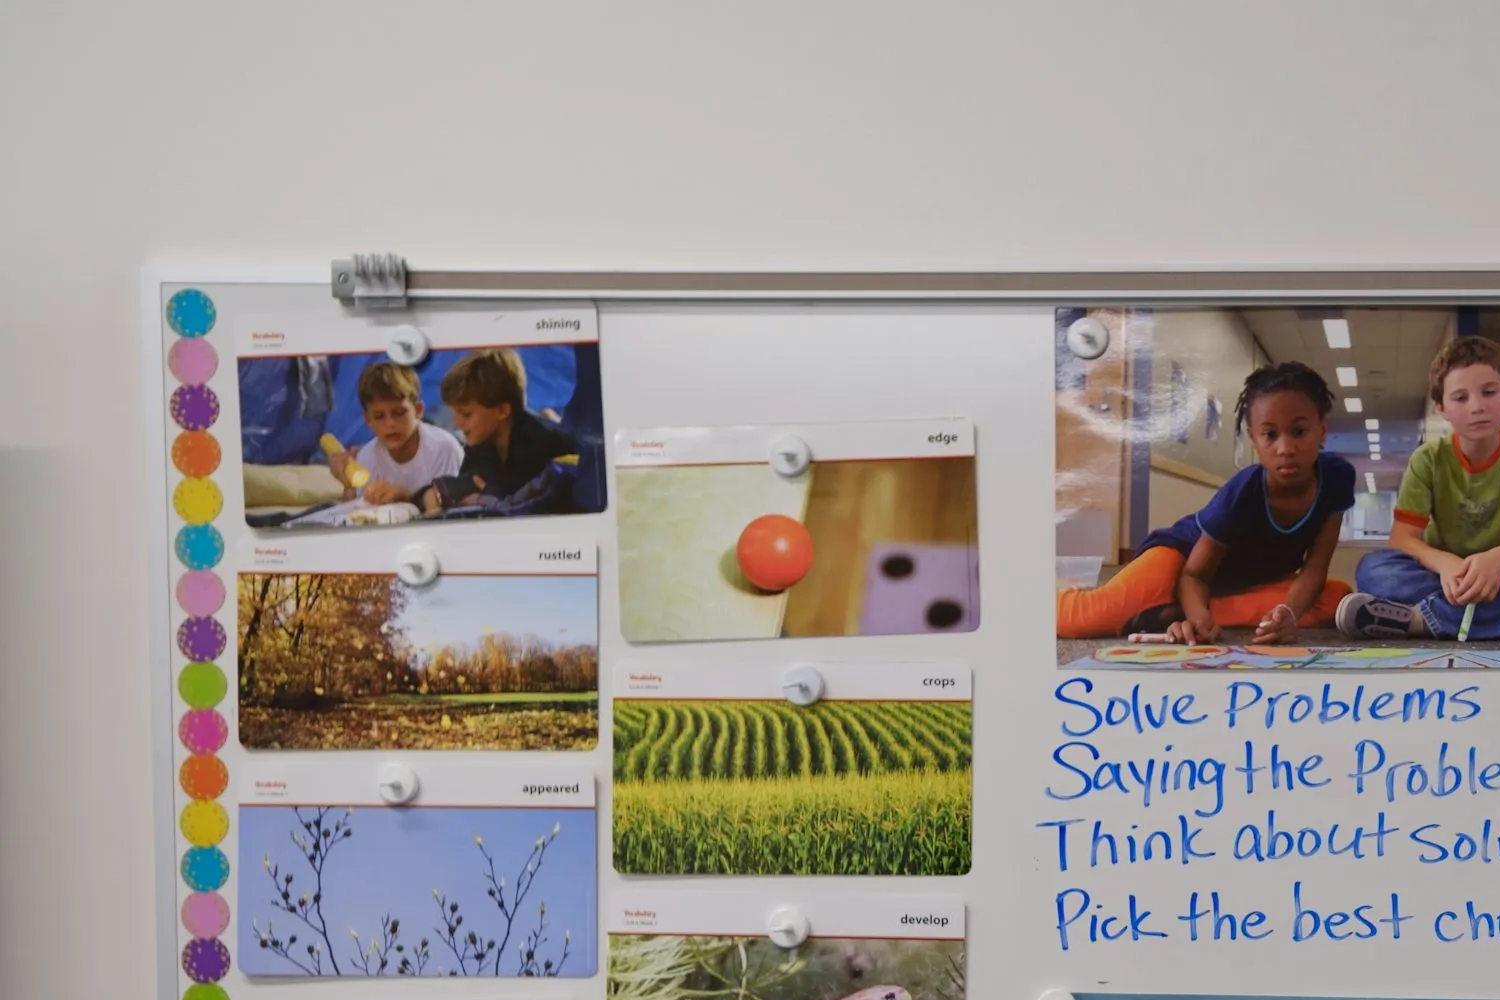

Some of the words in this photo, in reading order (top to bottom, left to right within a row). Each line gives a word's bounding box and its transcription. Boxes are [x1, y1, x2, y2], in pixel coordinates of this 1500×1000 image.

[535, 317, 581, 331] shining
[927, 432, 958, 445] edge
[538, 549, 582, 561] rustled
[922, 675, 956, 688] crops
[1055, 677, 1208, 737] Solve
[1225, 681, 1482, 728] Problems
[1045, 741, 1226, 817] Saying
[1236, 740, 1332, 794] the
[522, 782, 580, 795] appeared
[1036, 815, 1216, 872] Think
[1233, 810, 1401, 862] about
[900, 913, 949, 927] develop
[1056, 888, 1168, 950] Pick
[1178, 891, 1274, 942] the
[1292, 882, 1414, 942] best
